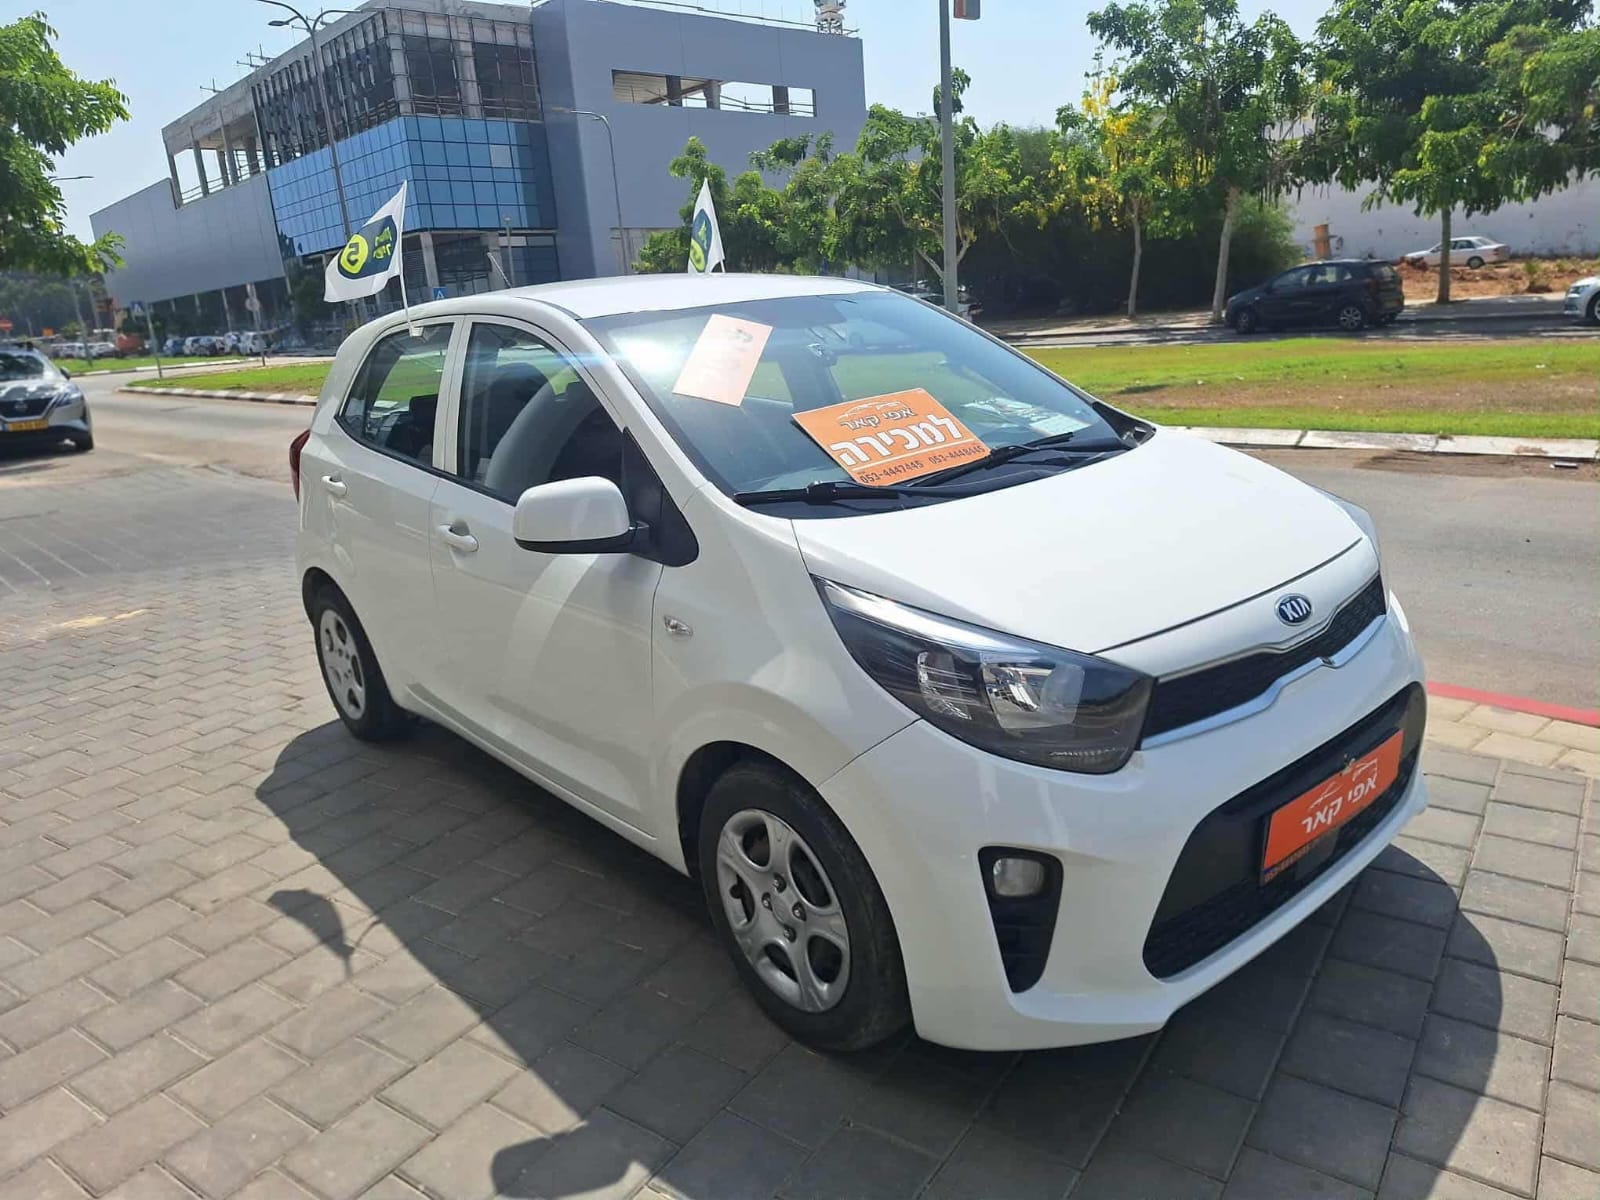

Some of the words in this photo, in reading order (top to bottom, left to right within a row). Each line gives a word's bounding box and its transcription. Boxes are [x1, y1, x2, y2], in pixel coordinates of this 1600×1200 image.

[840, 415, 880, 431] קאר
[884, 407, 915, 421] אפי
[830, 414, 963, 466] למכירה
[859, 460, 925, 484] 053-4447445
[1281, 598, 1310, 621] KIA
[1347, 777, 1377, 803] אפי
[1301, 797, 1344, 834] קאר
